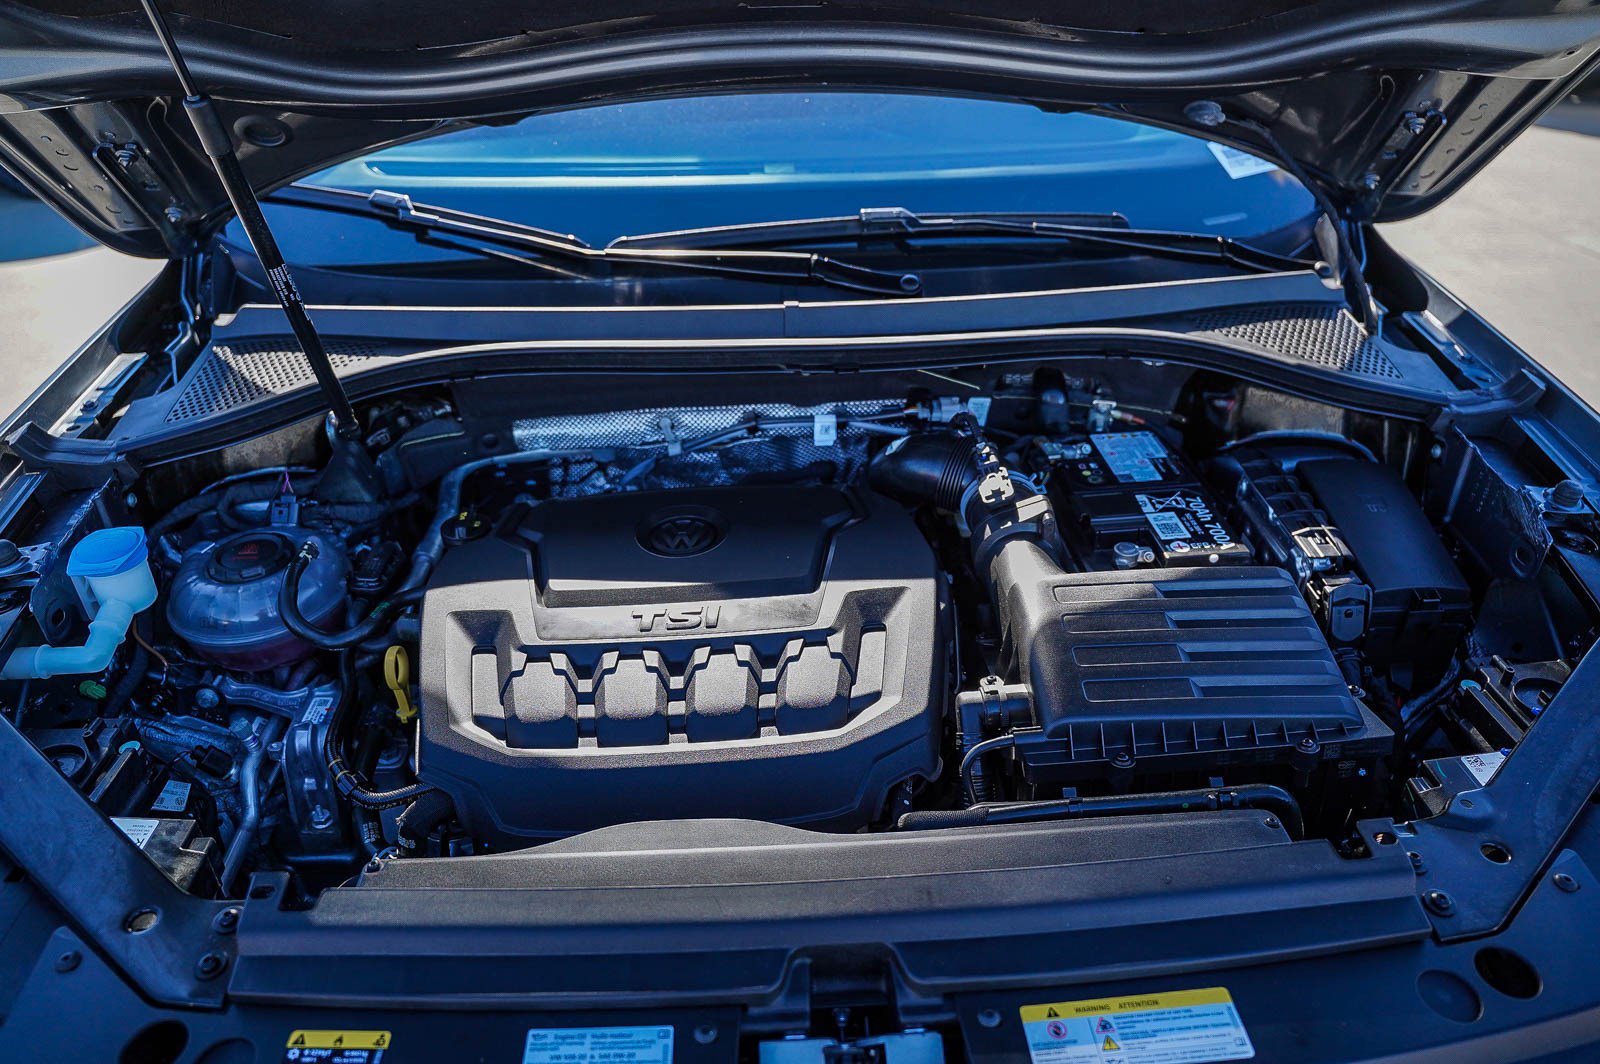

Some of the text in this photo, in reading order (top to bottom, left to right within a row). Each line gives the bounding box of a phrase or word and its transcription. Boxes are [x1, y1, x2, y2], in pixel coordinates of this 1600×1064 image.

[1185, 496, 1214, 522] 70Ah
[1204, 521, 1235, 551] 700A
[631, 605, 722, 633] TSI
[1074, 999, 1160, 1014] WARNING ATTENTION
